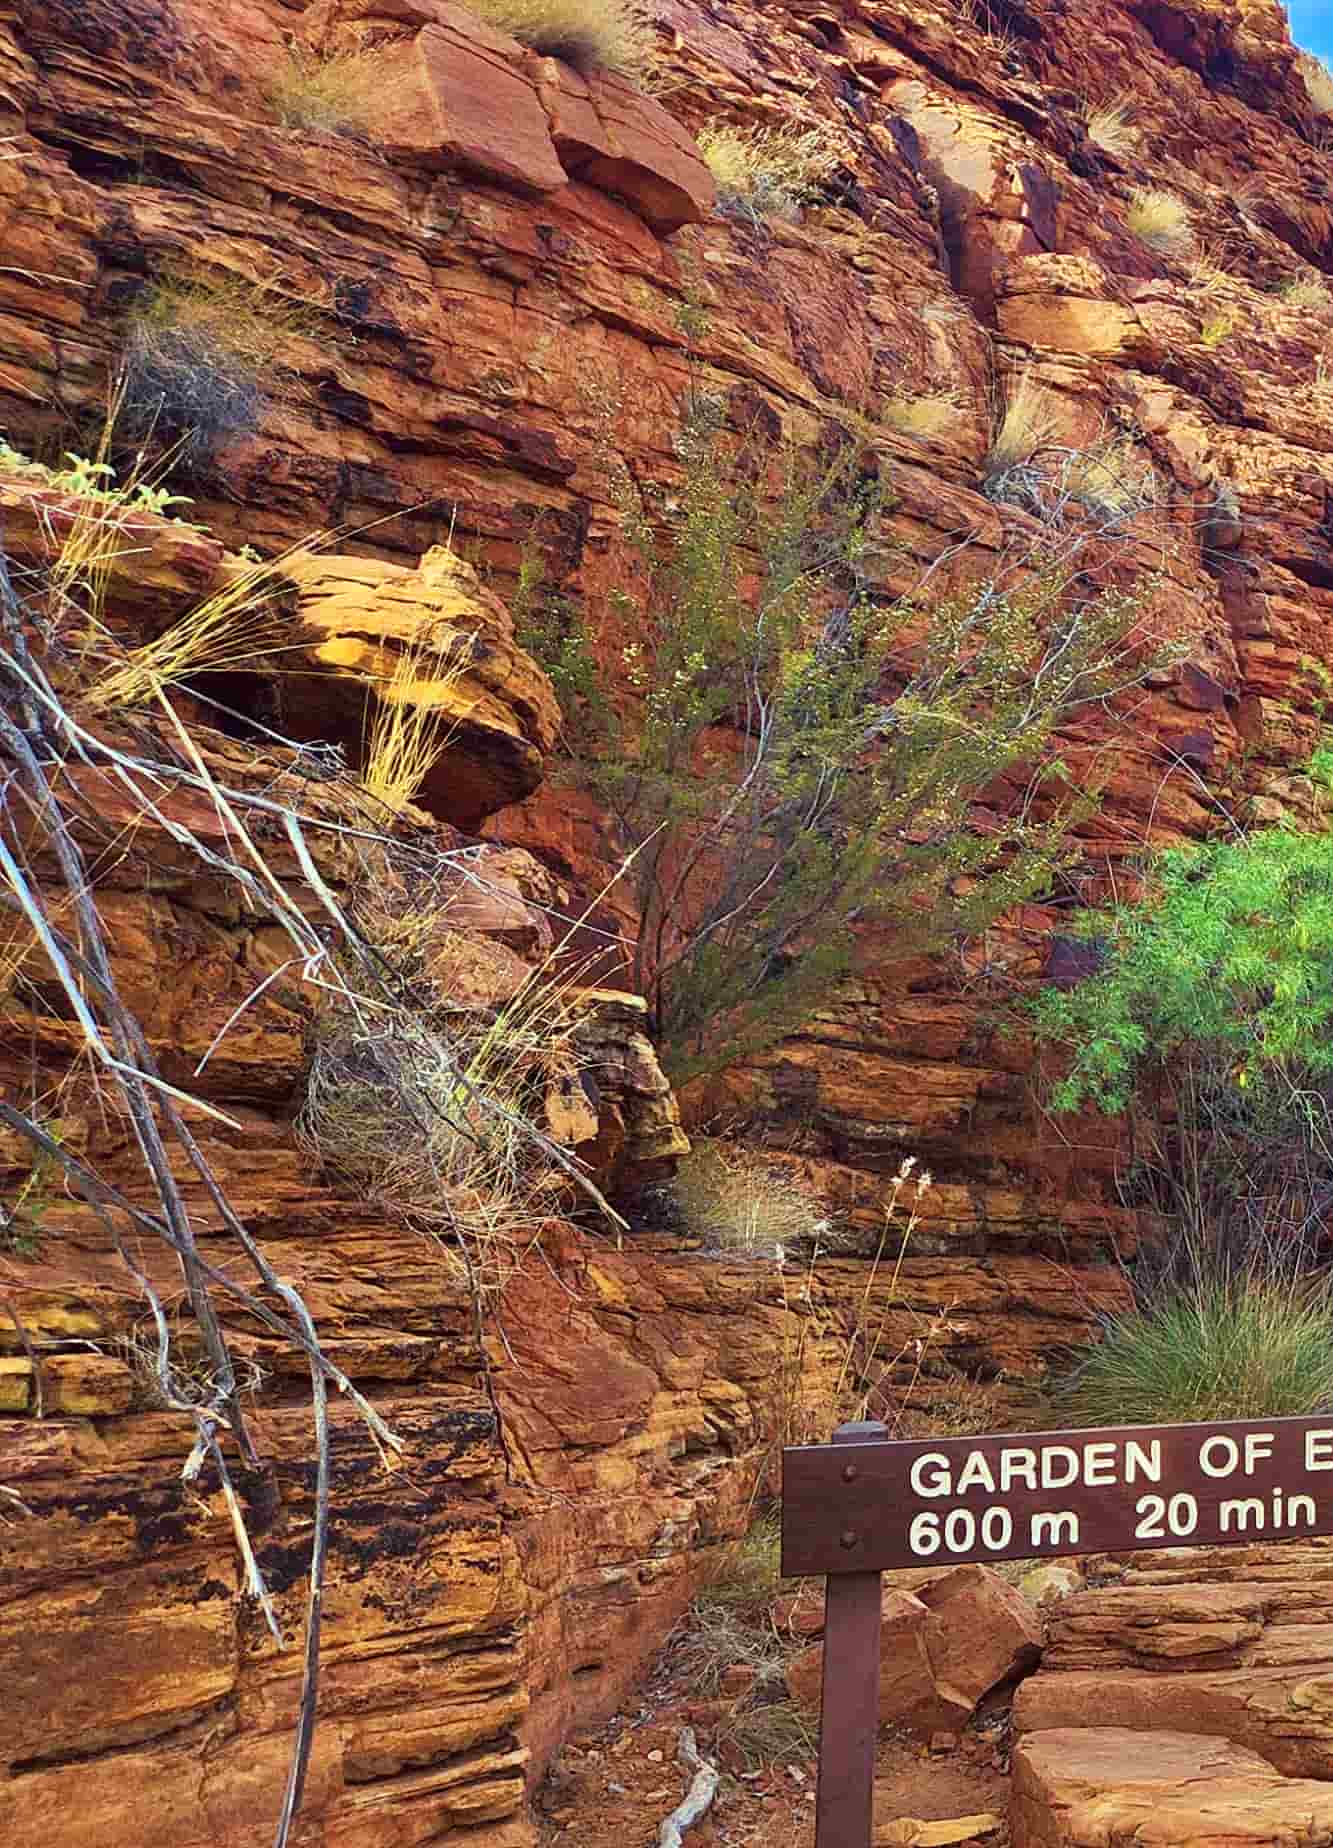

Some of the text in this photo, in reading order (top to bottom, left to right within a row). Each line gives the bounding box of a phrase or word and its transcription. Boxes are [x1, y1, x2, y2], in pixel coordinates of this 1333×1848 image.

[908, 1439, 1161, 1498] GARDEN
[1198, 1433, 1275, 1478] OF
[909, 1506, 1012, 1556] 600
[1031, 1511, 1079, 1546] m
[1135, 1493, 1198, 1539] 20
[1220, 1486, 1316, 1532] min
